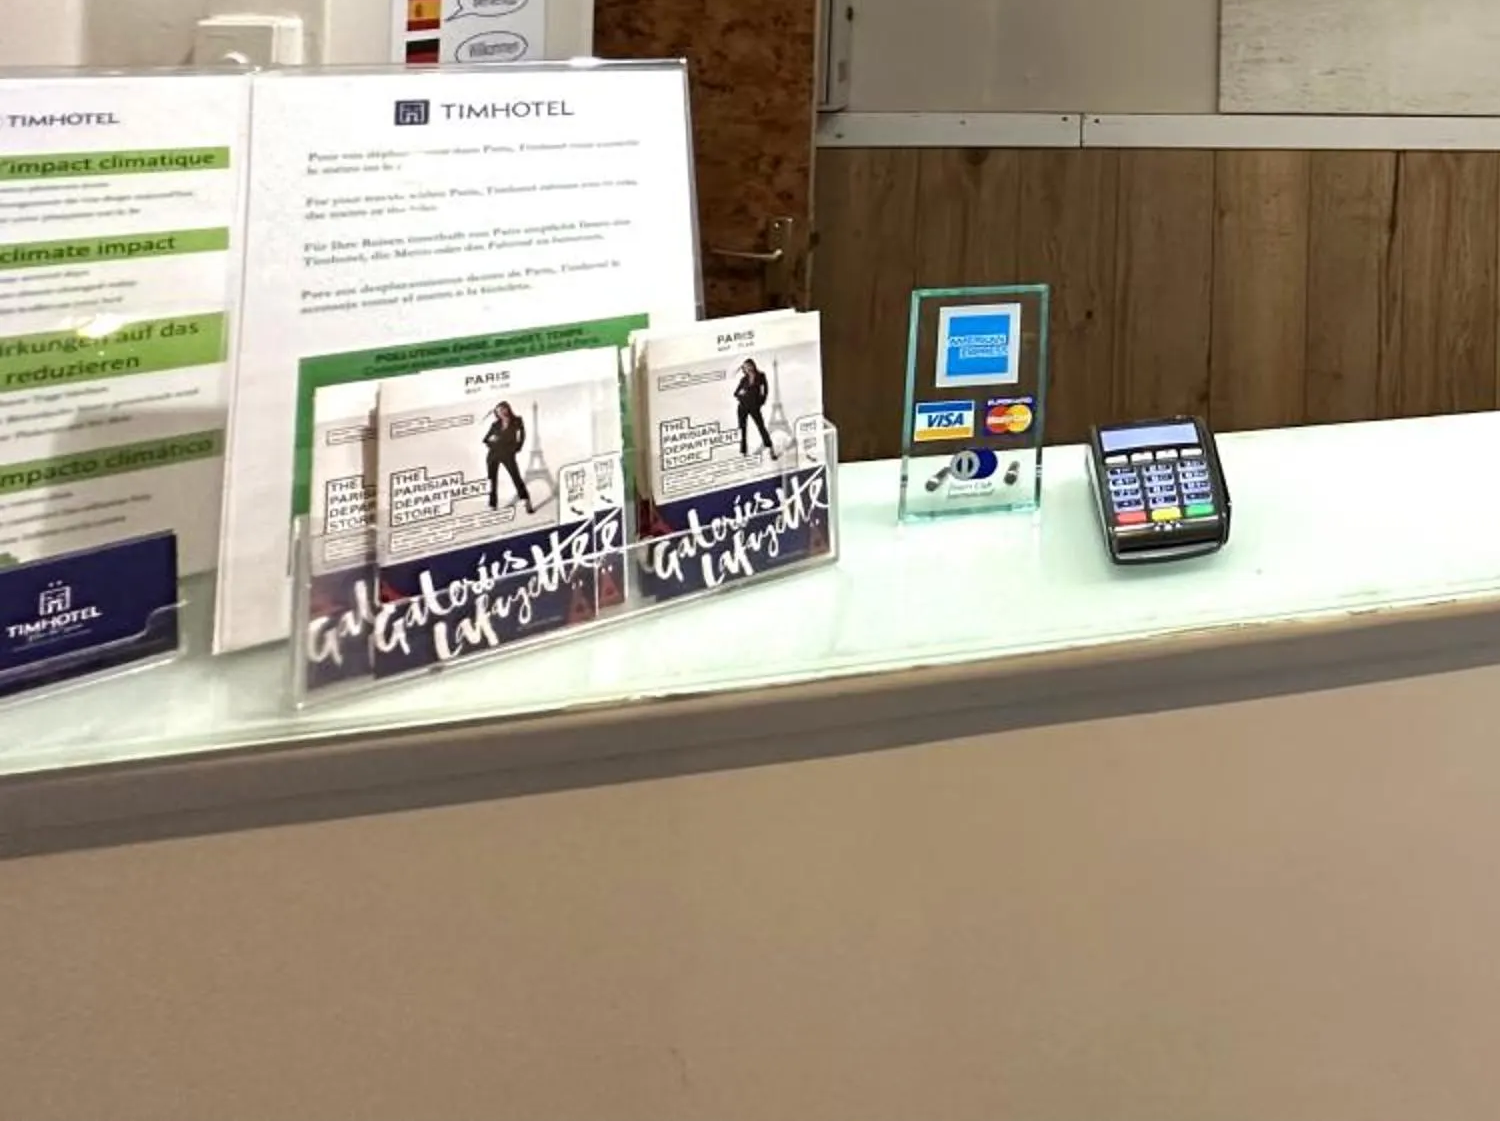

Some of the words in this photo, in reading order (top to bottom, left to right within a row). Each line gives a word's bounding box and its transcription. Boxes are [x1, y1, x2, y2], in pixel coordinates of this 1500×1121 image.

[440, 100, 574, 120] TIMHOTEL
[8, 112, 121, 128] TIMHOTEL
[98, 150, 216, 171] climatique
[0, 245, 90, 264] climate
[97, 236, 177, 257] impact
[115, 324, 153, 345] auf
[159, 321, 199, 339] das
[716, 330, 755, 345] PARIS
[6, 355, 140, 384] reduzieren
[464, 370, 511, 387] PARIS
[663, 422, 685, 433] THE
[927, 412, 965, 428] VISA
[663, 426, 718, 444] PARISIAN
[664, 431, 740, 456] DEPARTMENT
[665, 452, 702, 467] STORE
[0, 456, 98, 487] mpacto
[395, 472, 420, 486] THE
[331, 480, 358, 493] THE
[394, 478, 460, 499] PARISIAN
[395, 482, 488, 510] DEPARTMENT
[394, 505, 441, 523] STORE
[7, 605, 103, 639] TIMHOTEL
